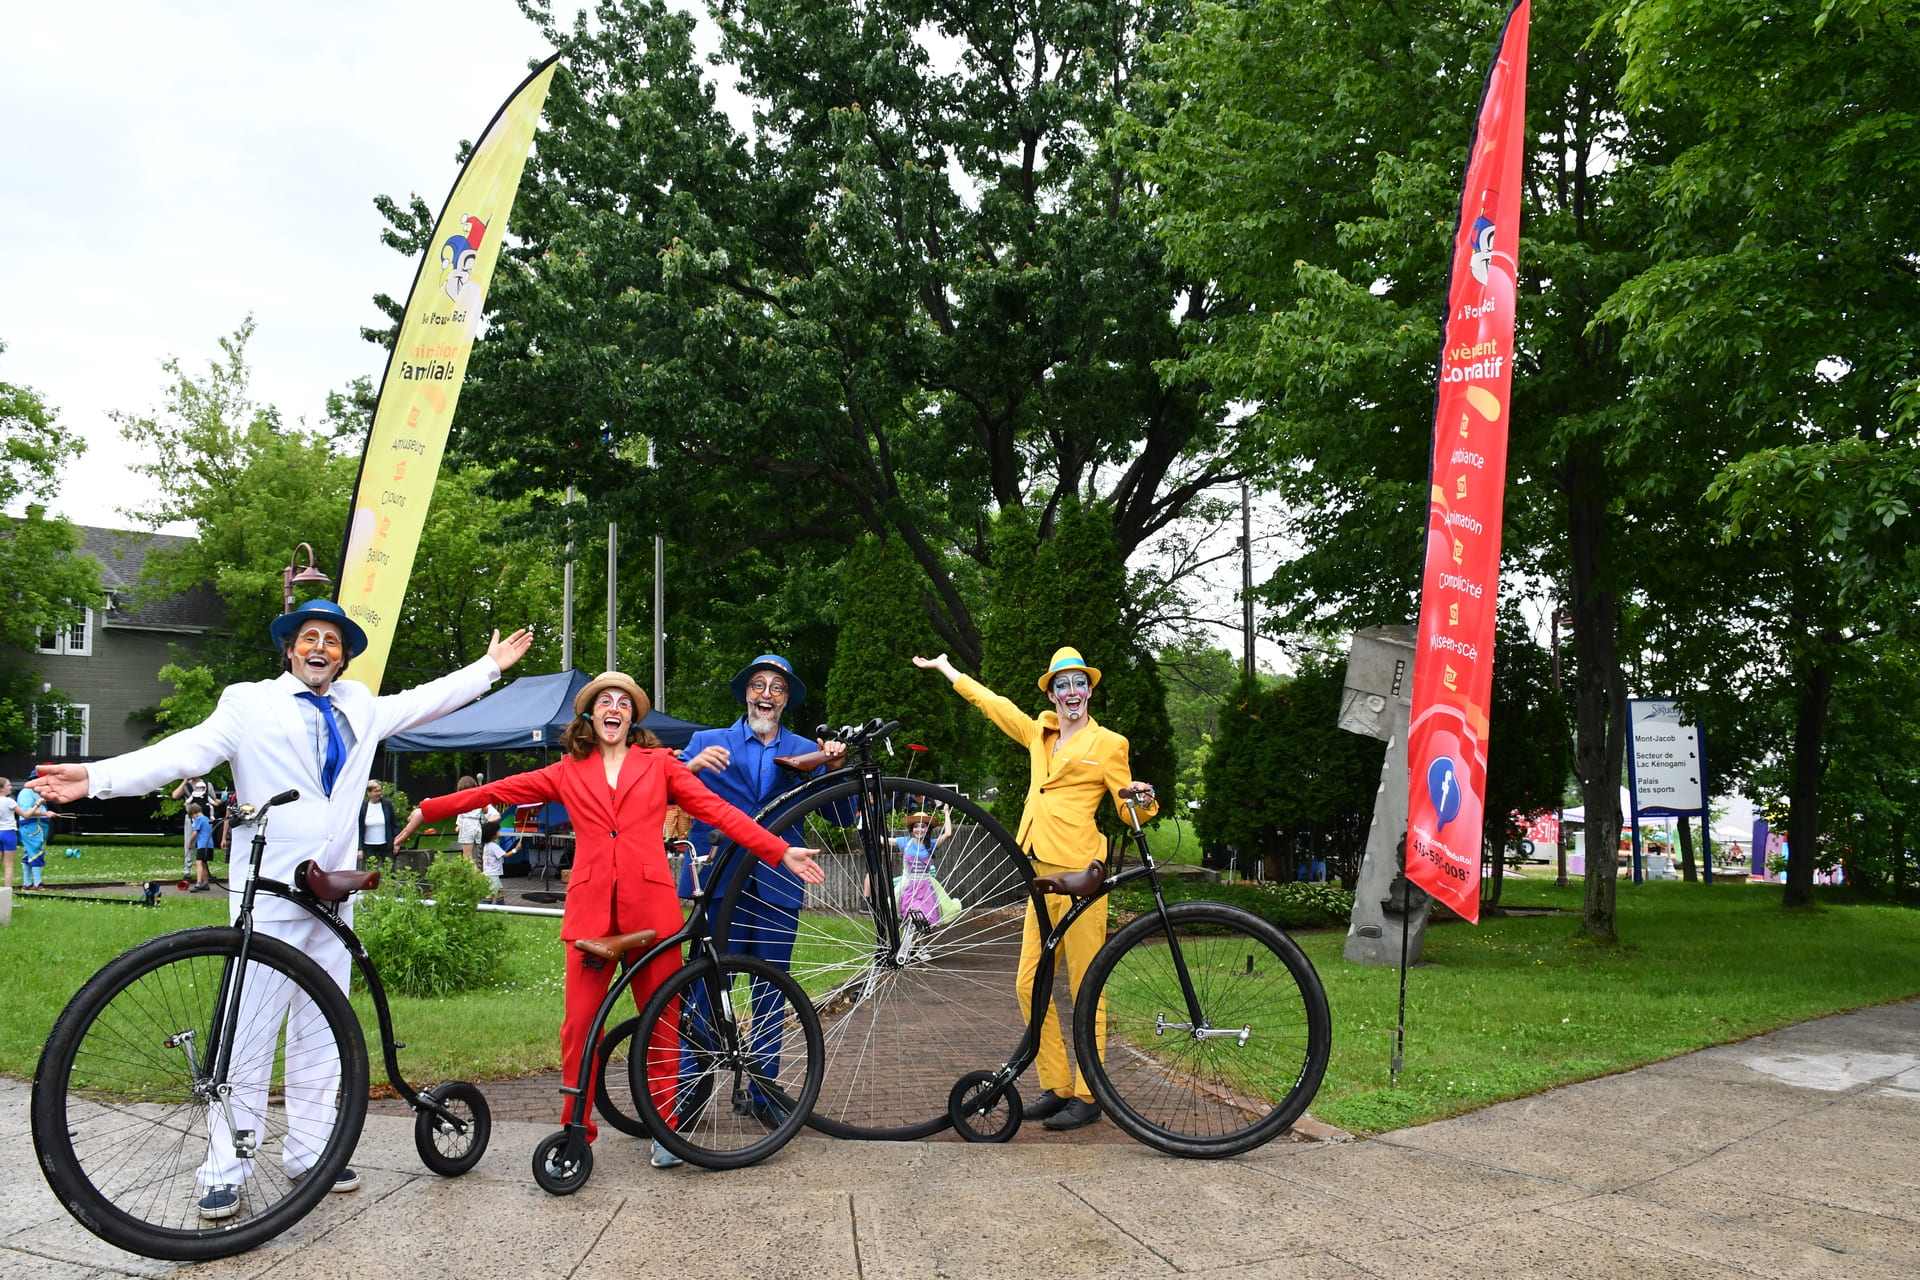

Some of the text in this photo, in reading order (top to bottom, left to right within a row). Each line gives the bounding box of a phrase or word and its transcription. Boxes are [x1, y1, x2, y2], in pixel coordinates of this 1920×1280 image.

[381, 490, 406, 508] Clowns
[1444, 510, 1483, 535] Animation
[366, 547, 390, 566] Ballons
[1438, 572, 1483, 599] Complicité
[1651, 760, 1686, 768] Kénogami
[1637, 777, 1659, 785] Palais
[1653, 786, 1675, 794] sports
